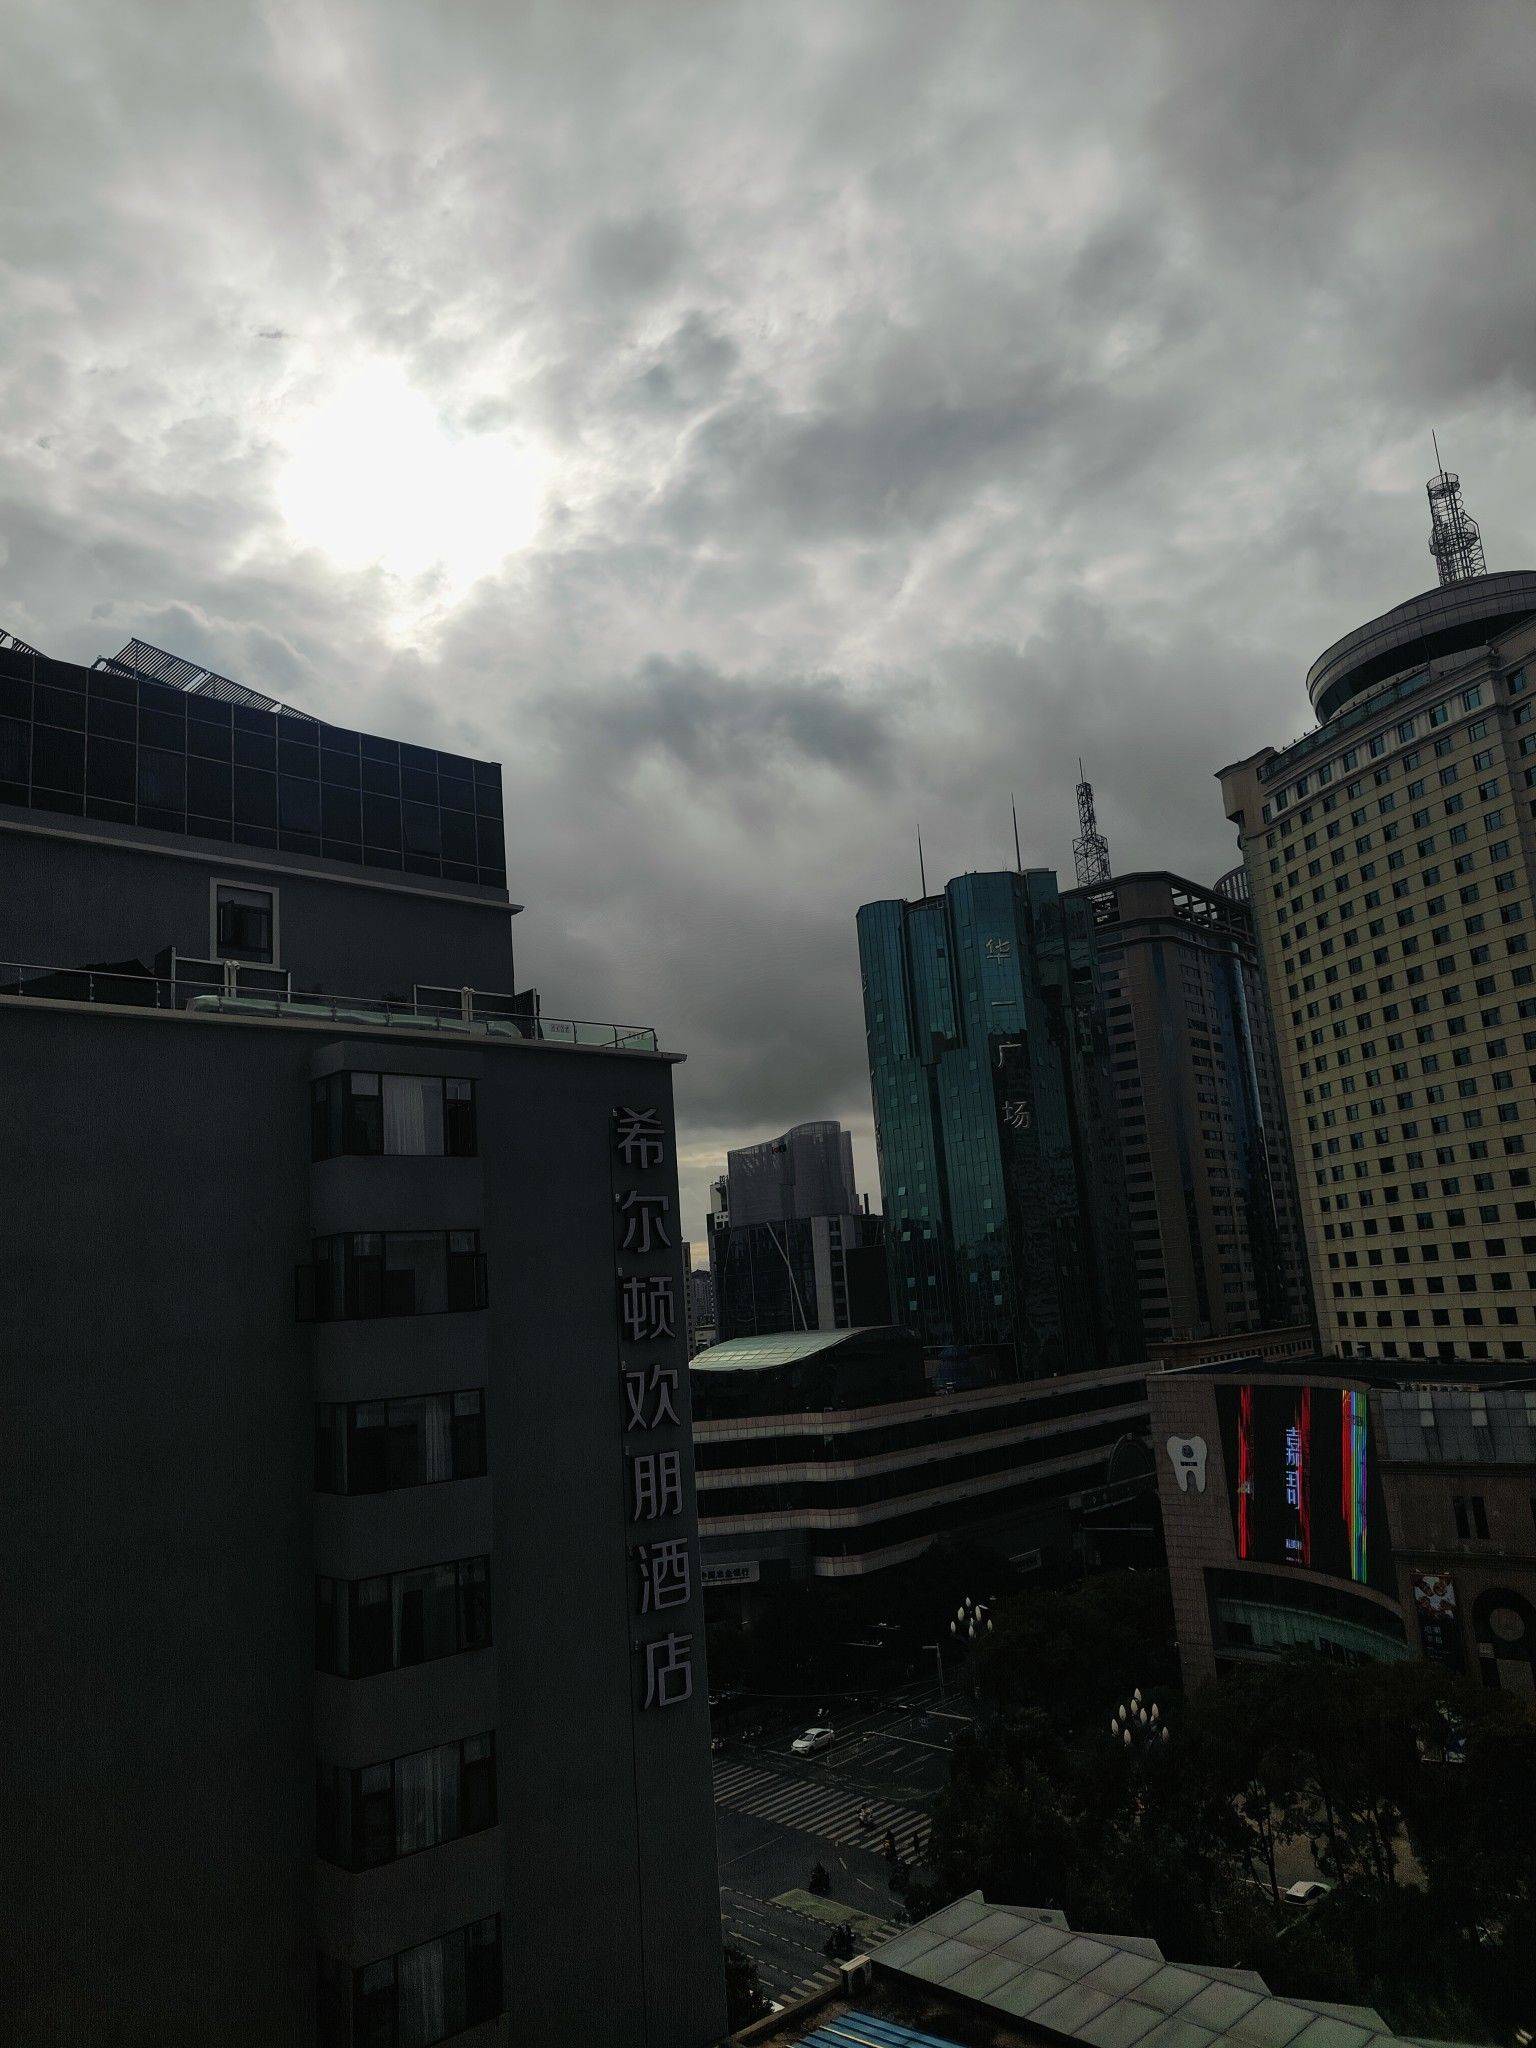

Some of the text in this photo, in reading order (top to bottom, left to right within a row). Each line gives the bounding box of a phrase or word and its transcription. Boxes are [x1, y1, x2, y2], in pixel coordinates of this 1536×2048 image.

[985, 937, 1032, 1129] 华一广场
[616, 1106, 695, 1711] 希尔顿欢朋酒店
